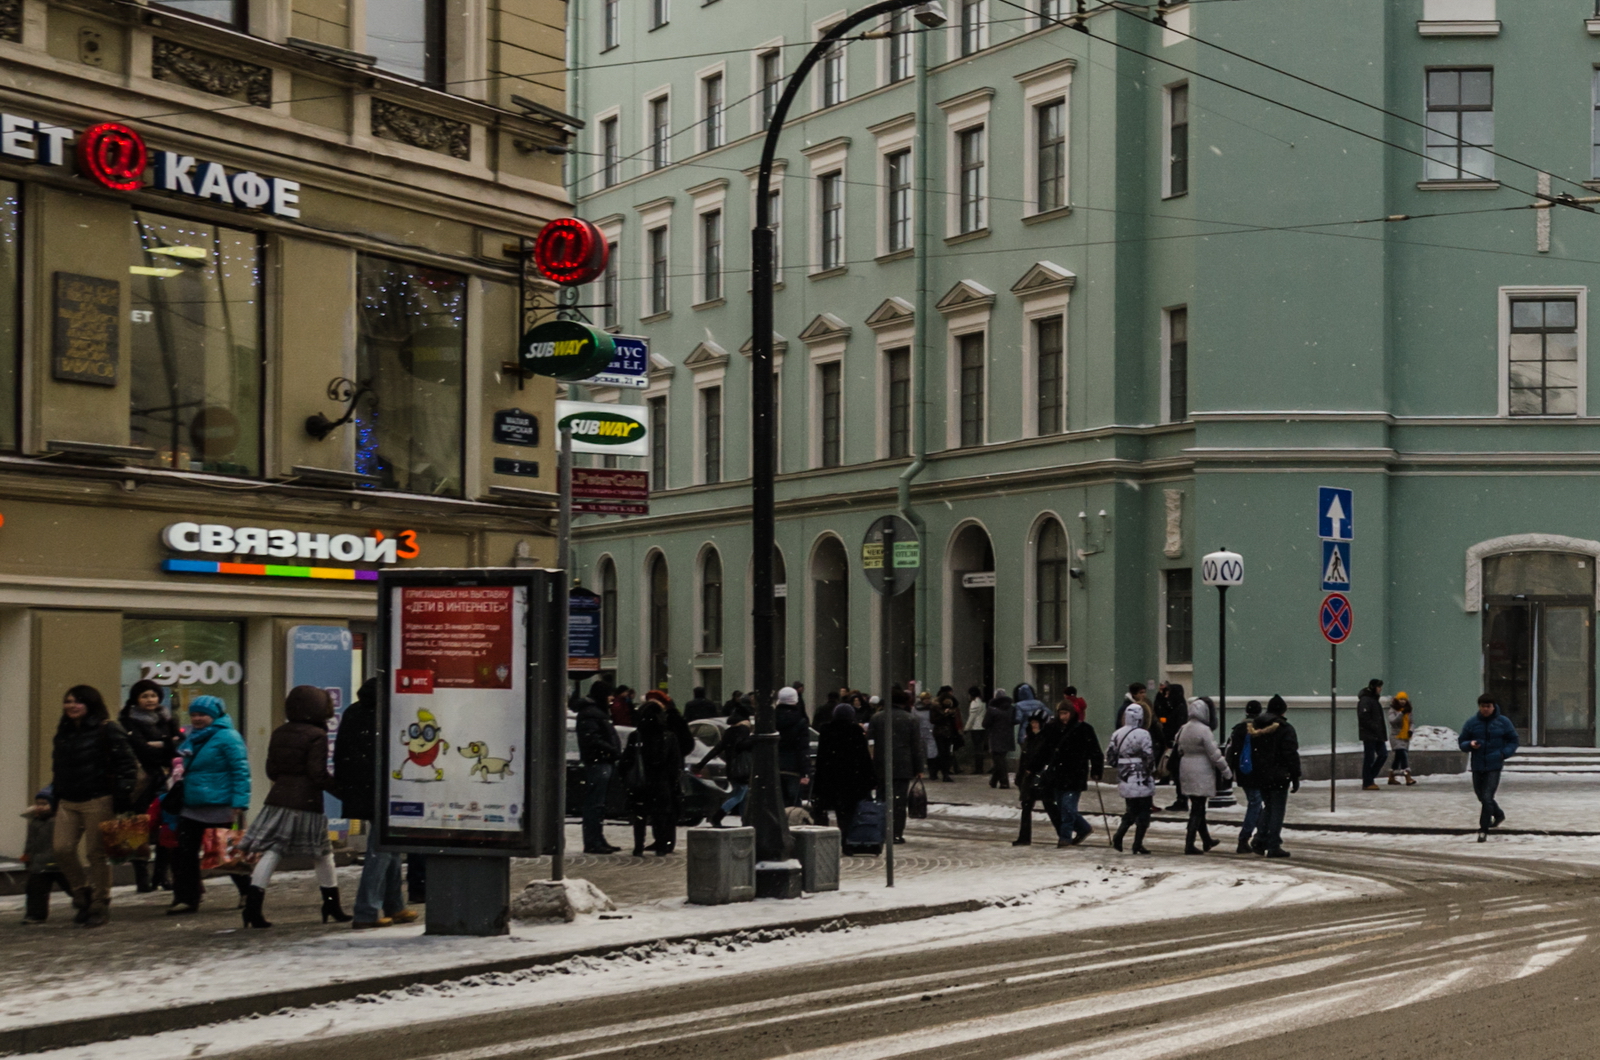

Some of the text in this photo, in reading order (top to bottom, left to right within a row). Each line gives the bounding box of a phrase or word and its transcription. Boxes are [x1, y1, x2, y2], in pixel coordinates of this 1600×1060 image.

[165, 151, 300, 219] КАФЕ
[525, 338, 589, 359] SUBWAY
[570, 418, 640, 438] SUBWAY
[513, 463, 520, 473] 2
[163, 521, 398, 564] СВЯЗНОЙ
[437, 601, 445, 612] В
